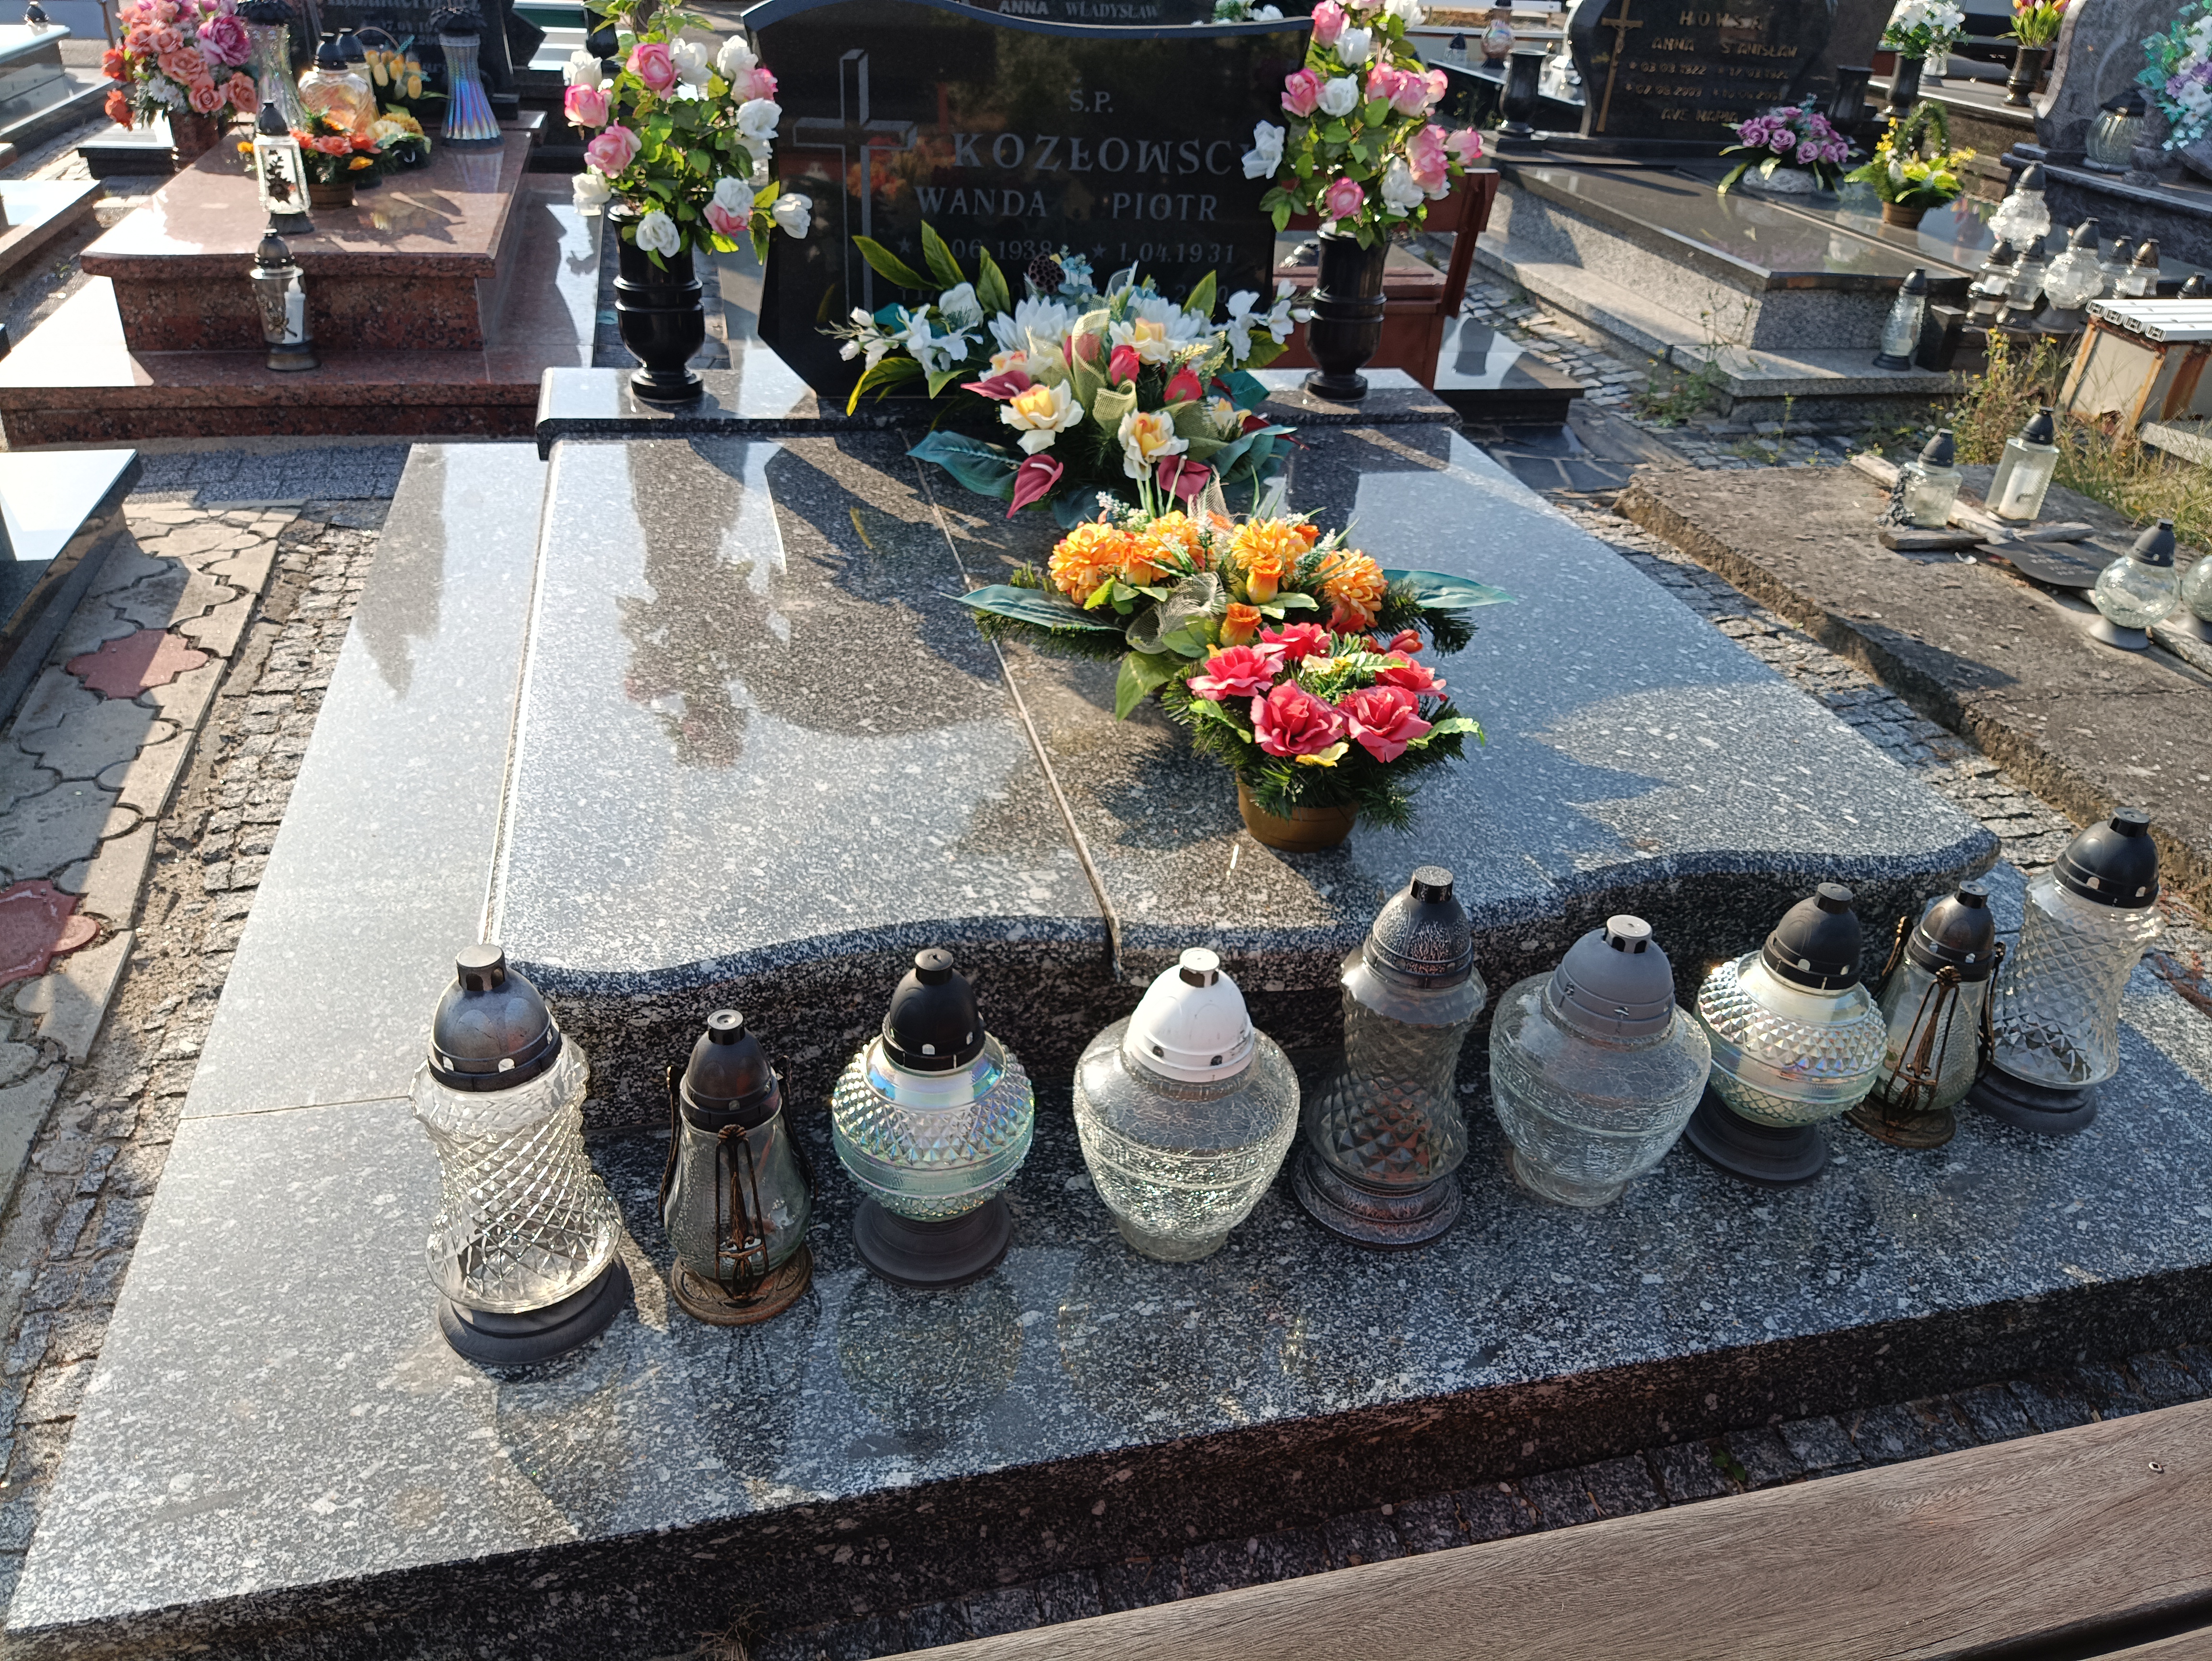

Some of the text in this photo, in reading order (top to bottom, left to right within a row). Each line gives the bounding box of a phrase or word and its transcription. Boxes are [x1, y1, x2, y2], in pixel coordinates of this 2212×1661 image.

[998, 0, 1049, 15] ANNA
[1651, 36, 1694, 51] ANNA
[952, 132, 1253, 176] KOZŁOWSC
[914, 187, 1218, 221] WANDA PIOTR
